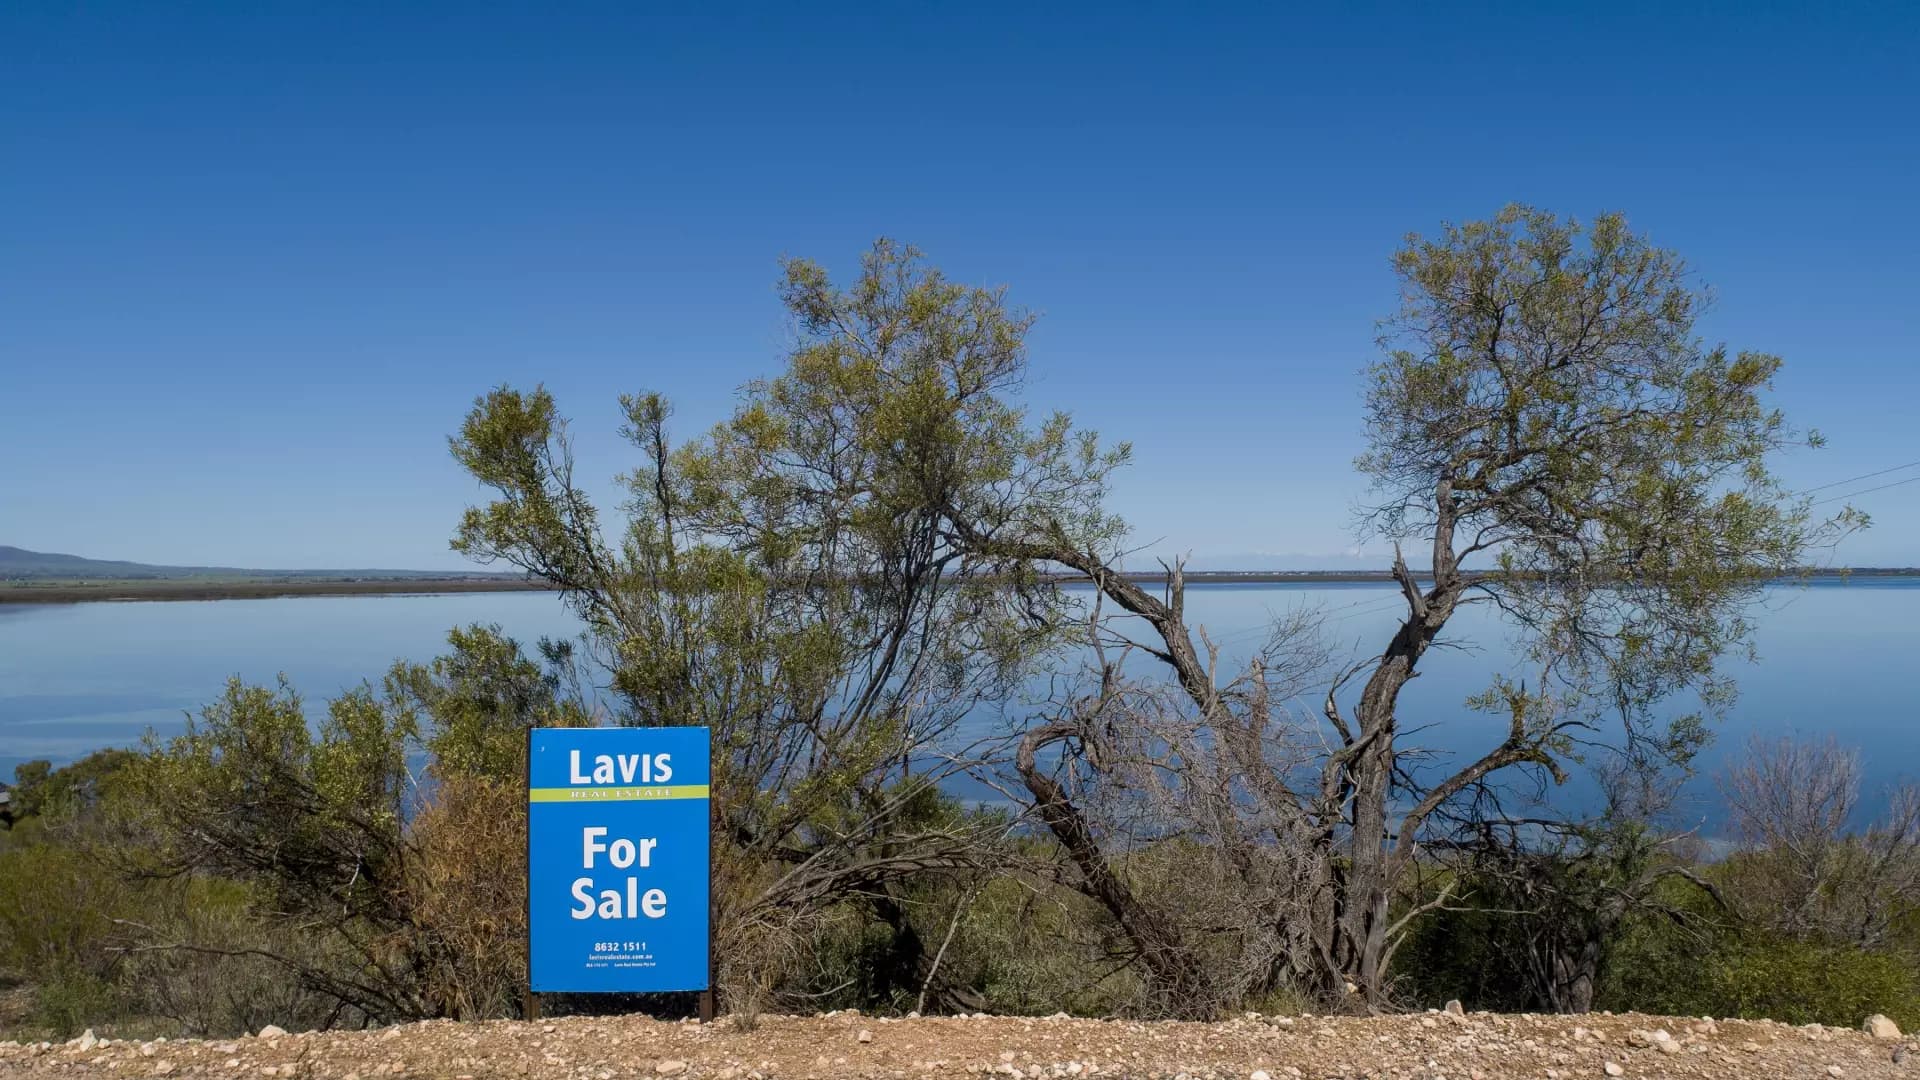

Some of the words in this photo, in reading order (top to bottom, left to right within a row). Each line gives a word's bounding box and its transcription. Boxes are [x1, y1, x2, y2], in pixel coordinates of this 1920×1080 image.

[570, 749, 673, 785] Lavis
[571, 790, 609, 799] REAL
[616, 788, 672, 798] ESTATE
[583, 826, 657, 869] For
[571, 877, 667, 920] Sale
[594, 942, 619, 952] 8632
[623, 942, 646, 952] 1511
